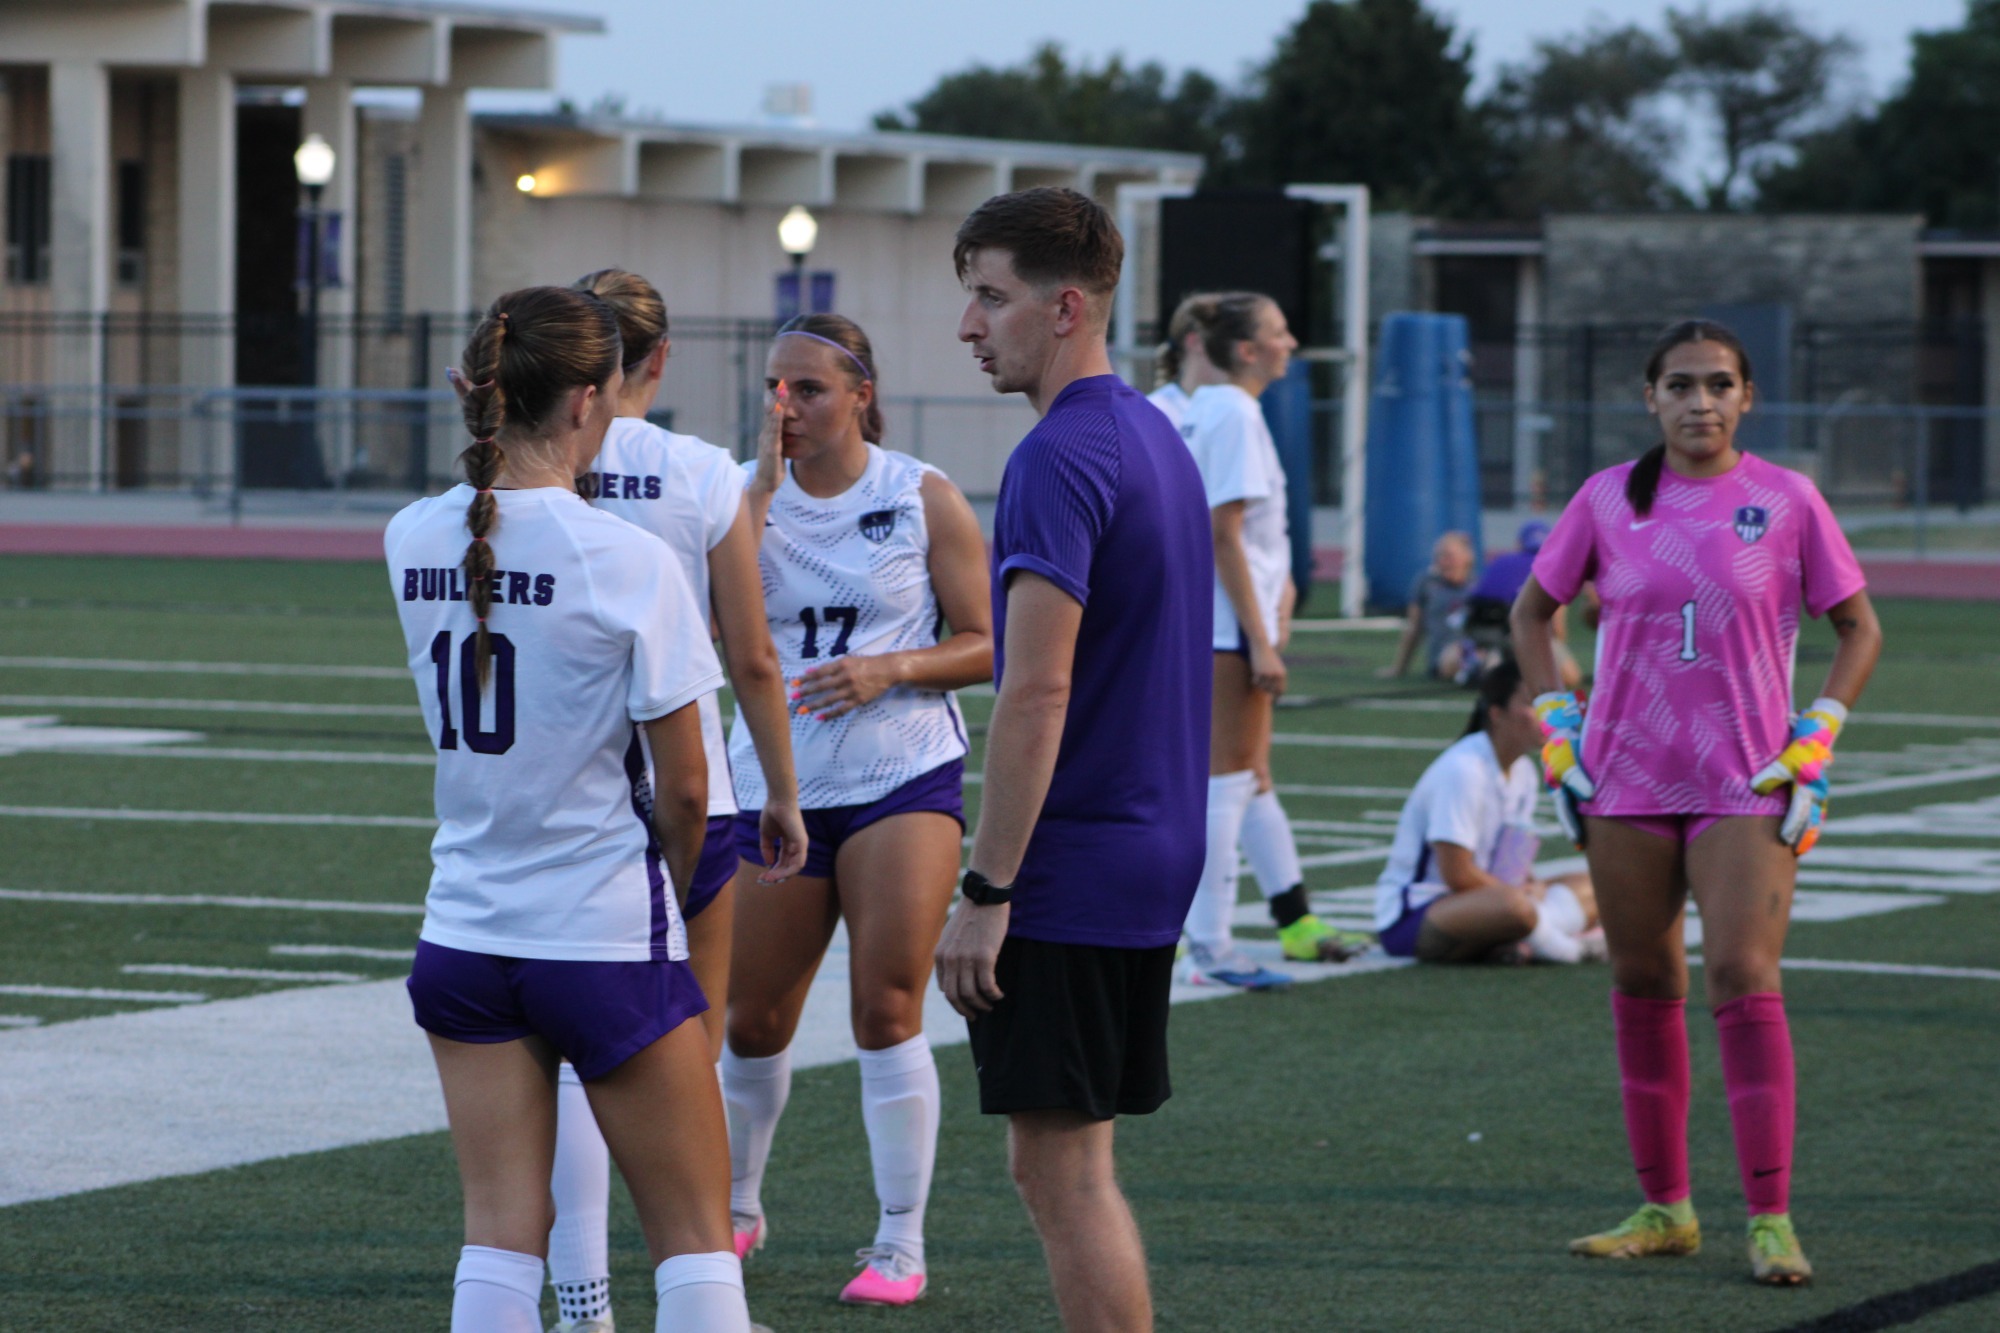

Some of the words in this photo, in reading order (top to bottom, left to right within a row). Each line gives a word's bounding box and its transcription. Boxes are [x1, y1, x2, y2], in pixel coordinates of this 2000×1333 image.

[799, 606, 859, 659] 17
[1679, 600, 1698, 661] 1
[431, 630, 516, 755] 10
